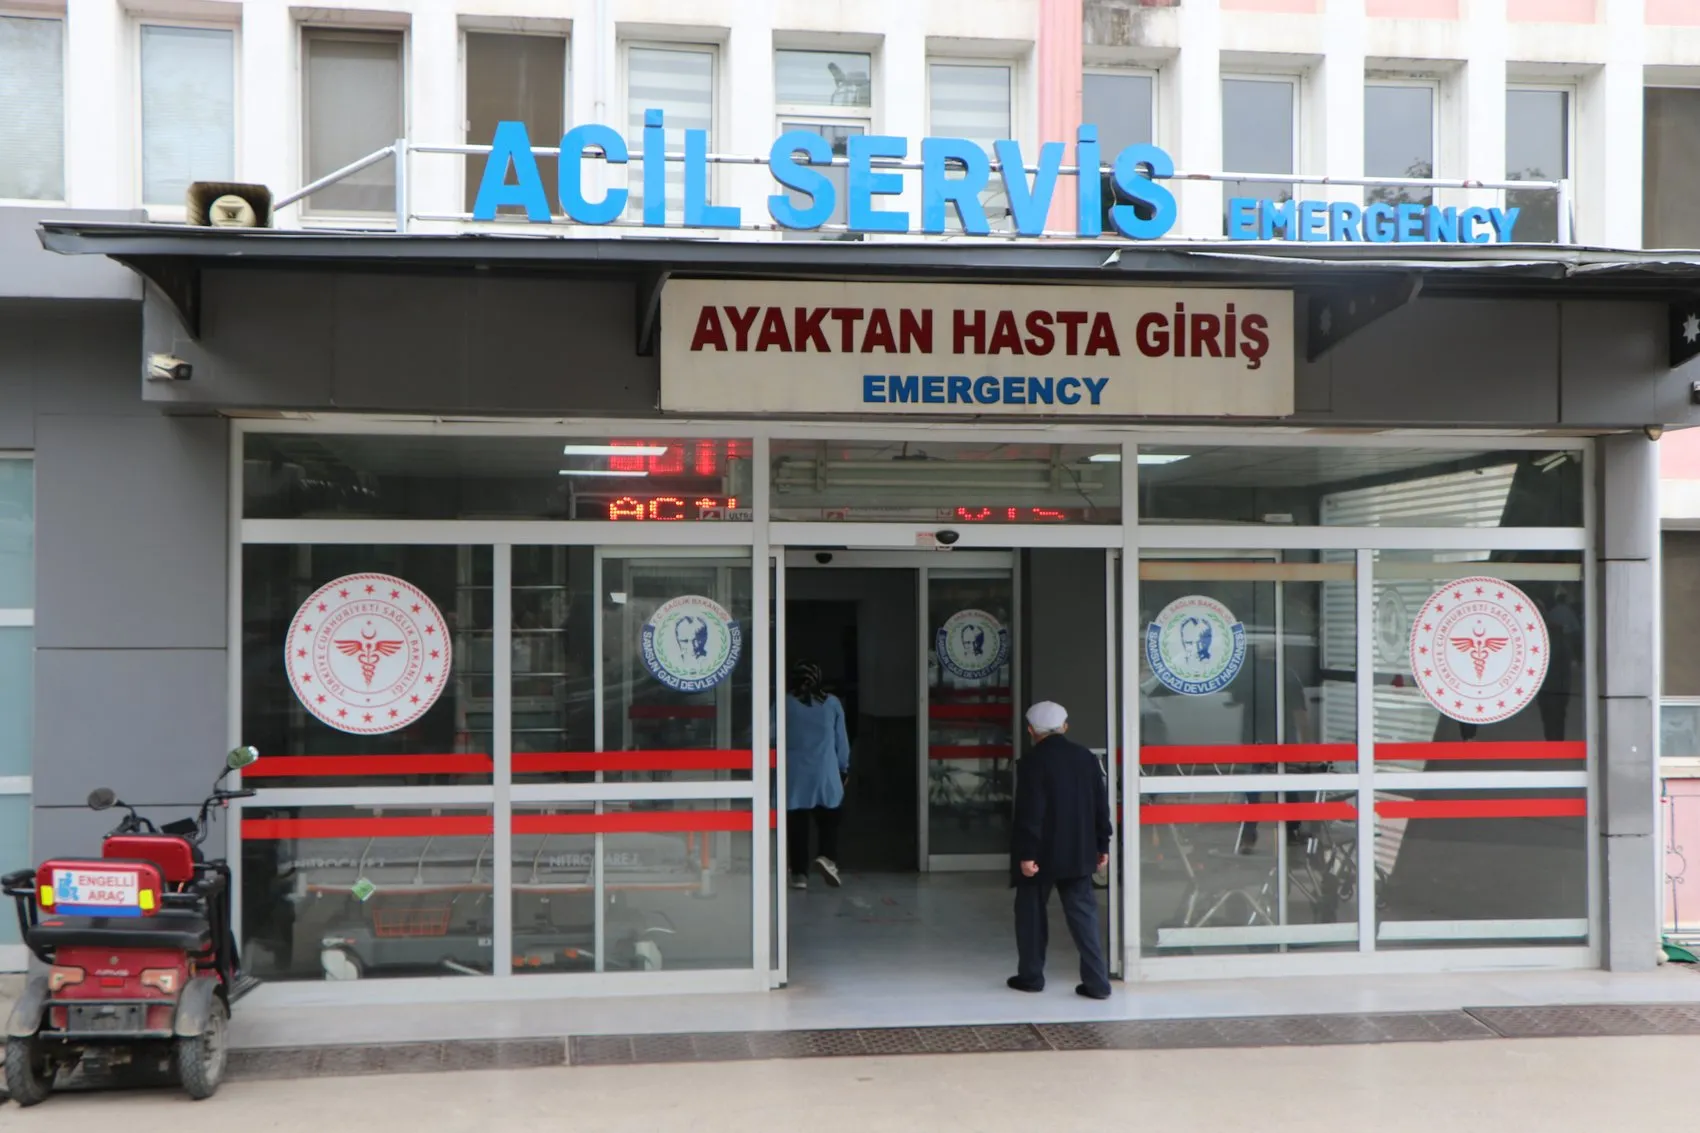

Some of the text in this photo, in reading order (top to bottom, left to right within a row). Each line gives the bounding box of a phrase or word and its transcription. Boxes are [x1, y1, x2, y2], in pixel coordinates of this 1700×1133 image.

[472, 108, 1178, 239] ACİL SERVİS
[1227, 197, 1520, 243] EMERGENCY
[690, 302, 1270, 370] AYAKTAN HASTA GİRİŞ
[863, 374, 1109, 405] EMERGENCY
[642, 630, 660, 673] SAMSUN
[657, 670, 679, 688] GAZİ
[680, 674, 719, 690] DEVLET
[1147, 631, 1164, 674] SAMSUN
[1161, 671, 1183, 690] GAZİ
[1184, 677, 1221, 693] DEVLET
[78, 874, 134, 888] ENGELLİ
[549, 852, 628, 866] NITROARE
[88, 890, 125, 904] ARAÇ
